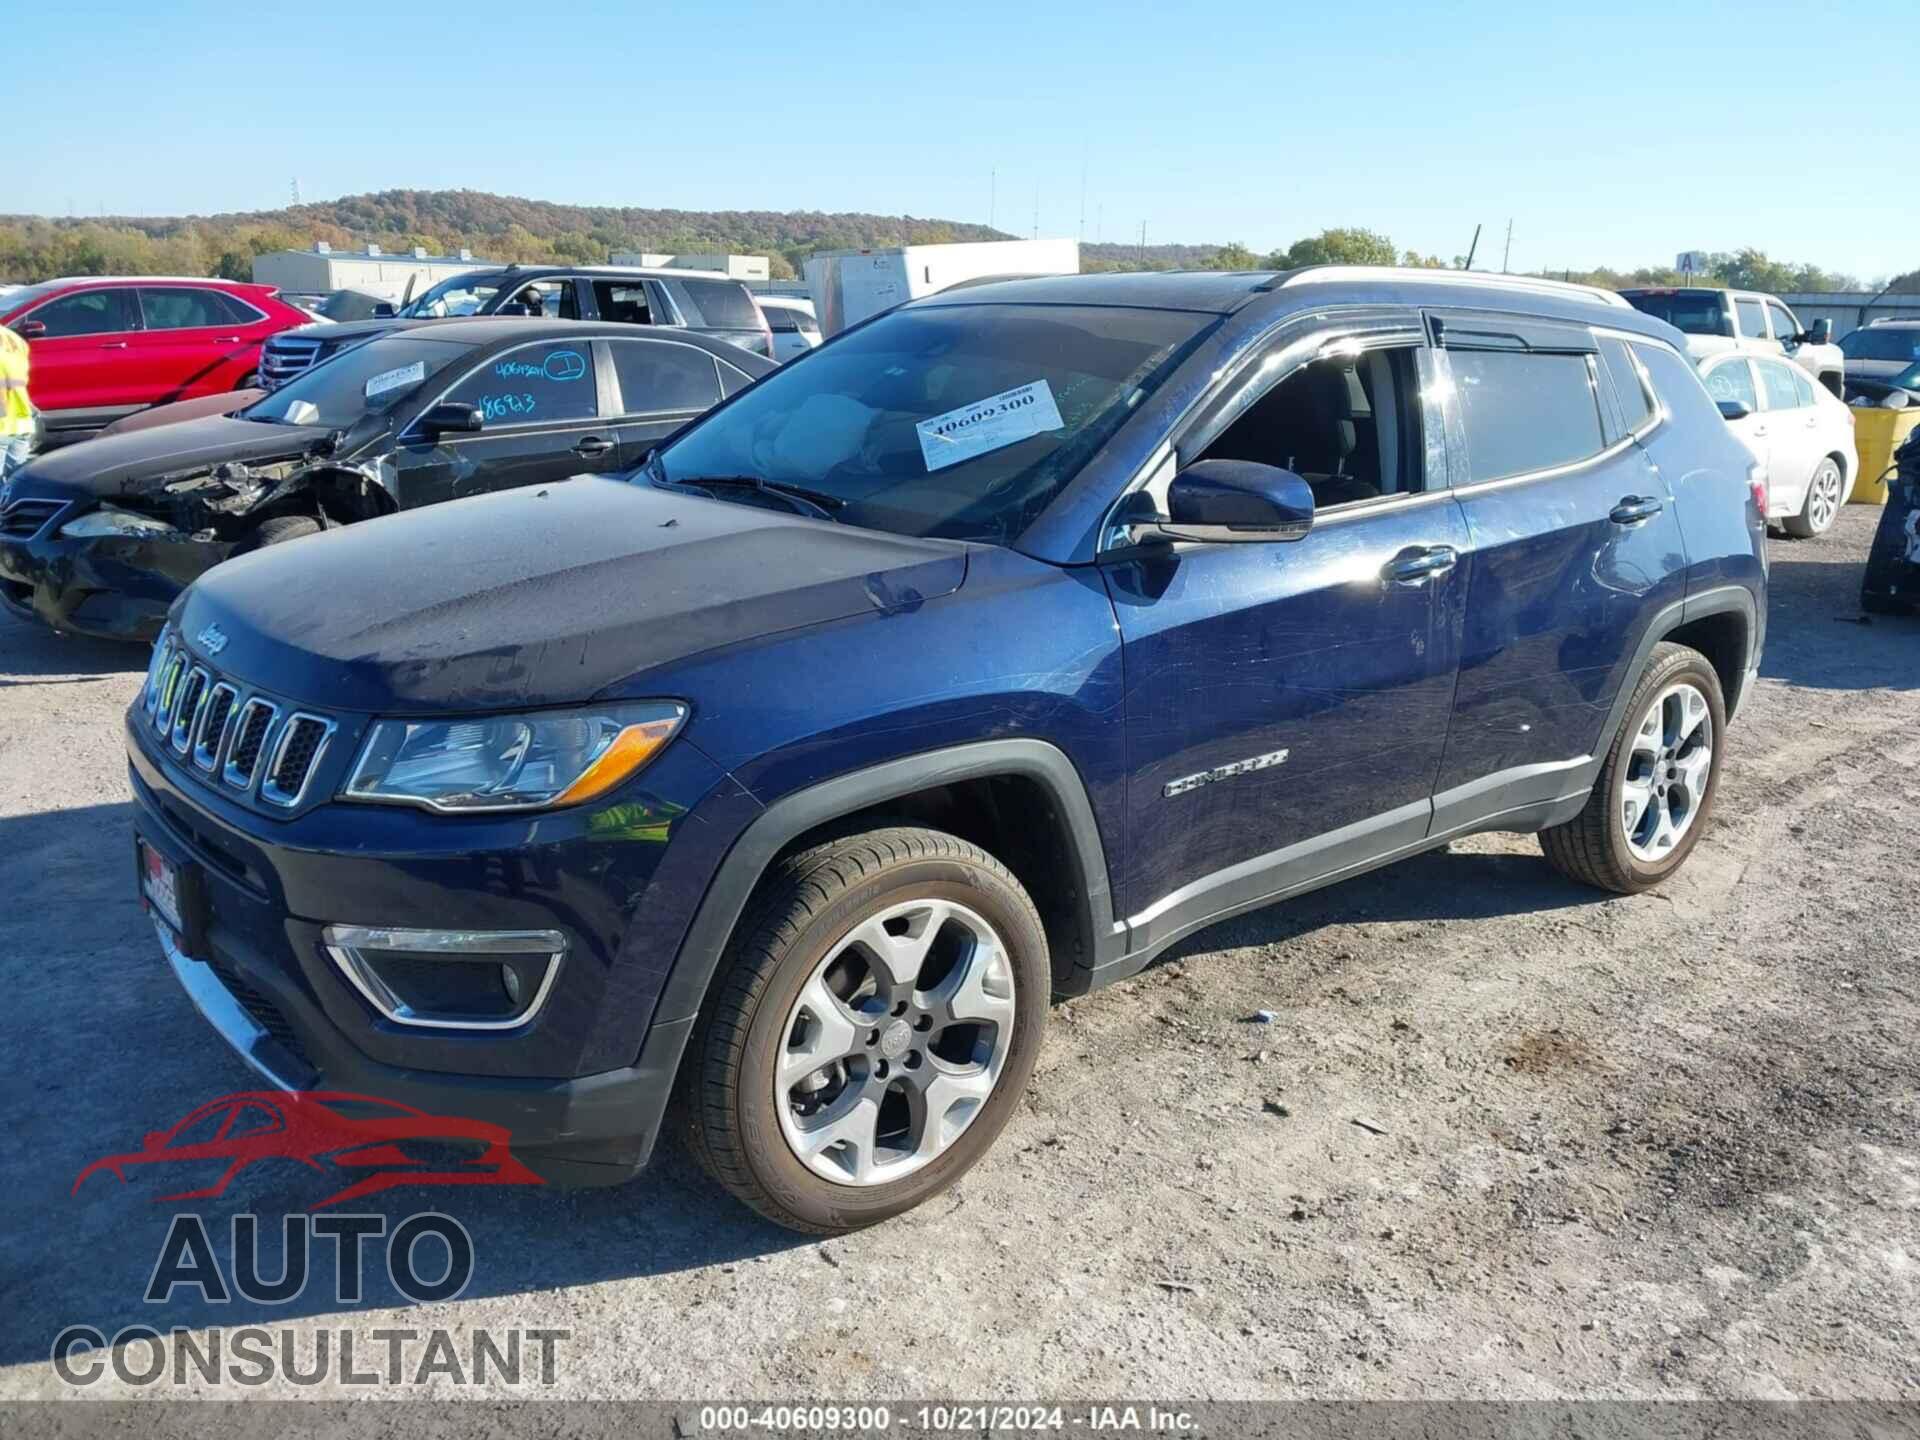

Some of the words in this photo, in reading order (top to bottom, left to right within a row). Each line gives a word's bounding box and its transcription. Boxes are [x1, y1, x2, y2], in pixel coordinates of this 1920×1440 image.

[1681, 253, 1693, 271] A
[934, 394, 1035, 436] 40609300
[197, 621, 228, 656] Jeep
